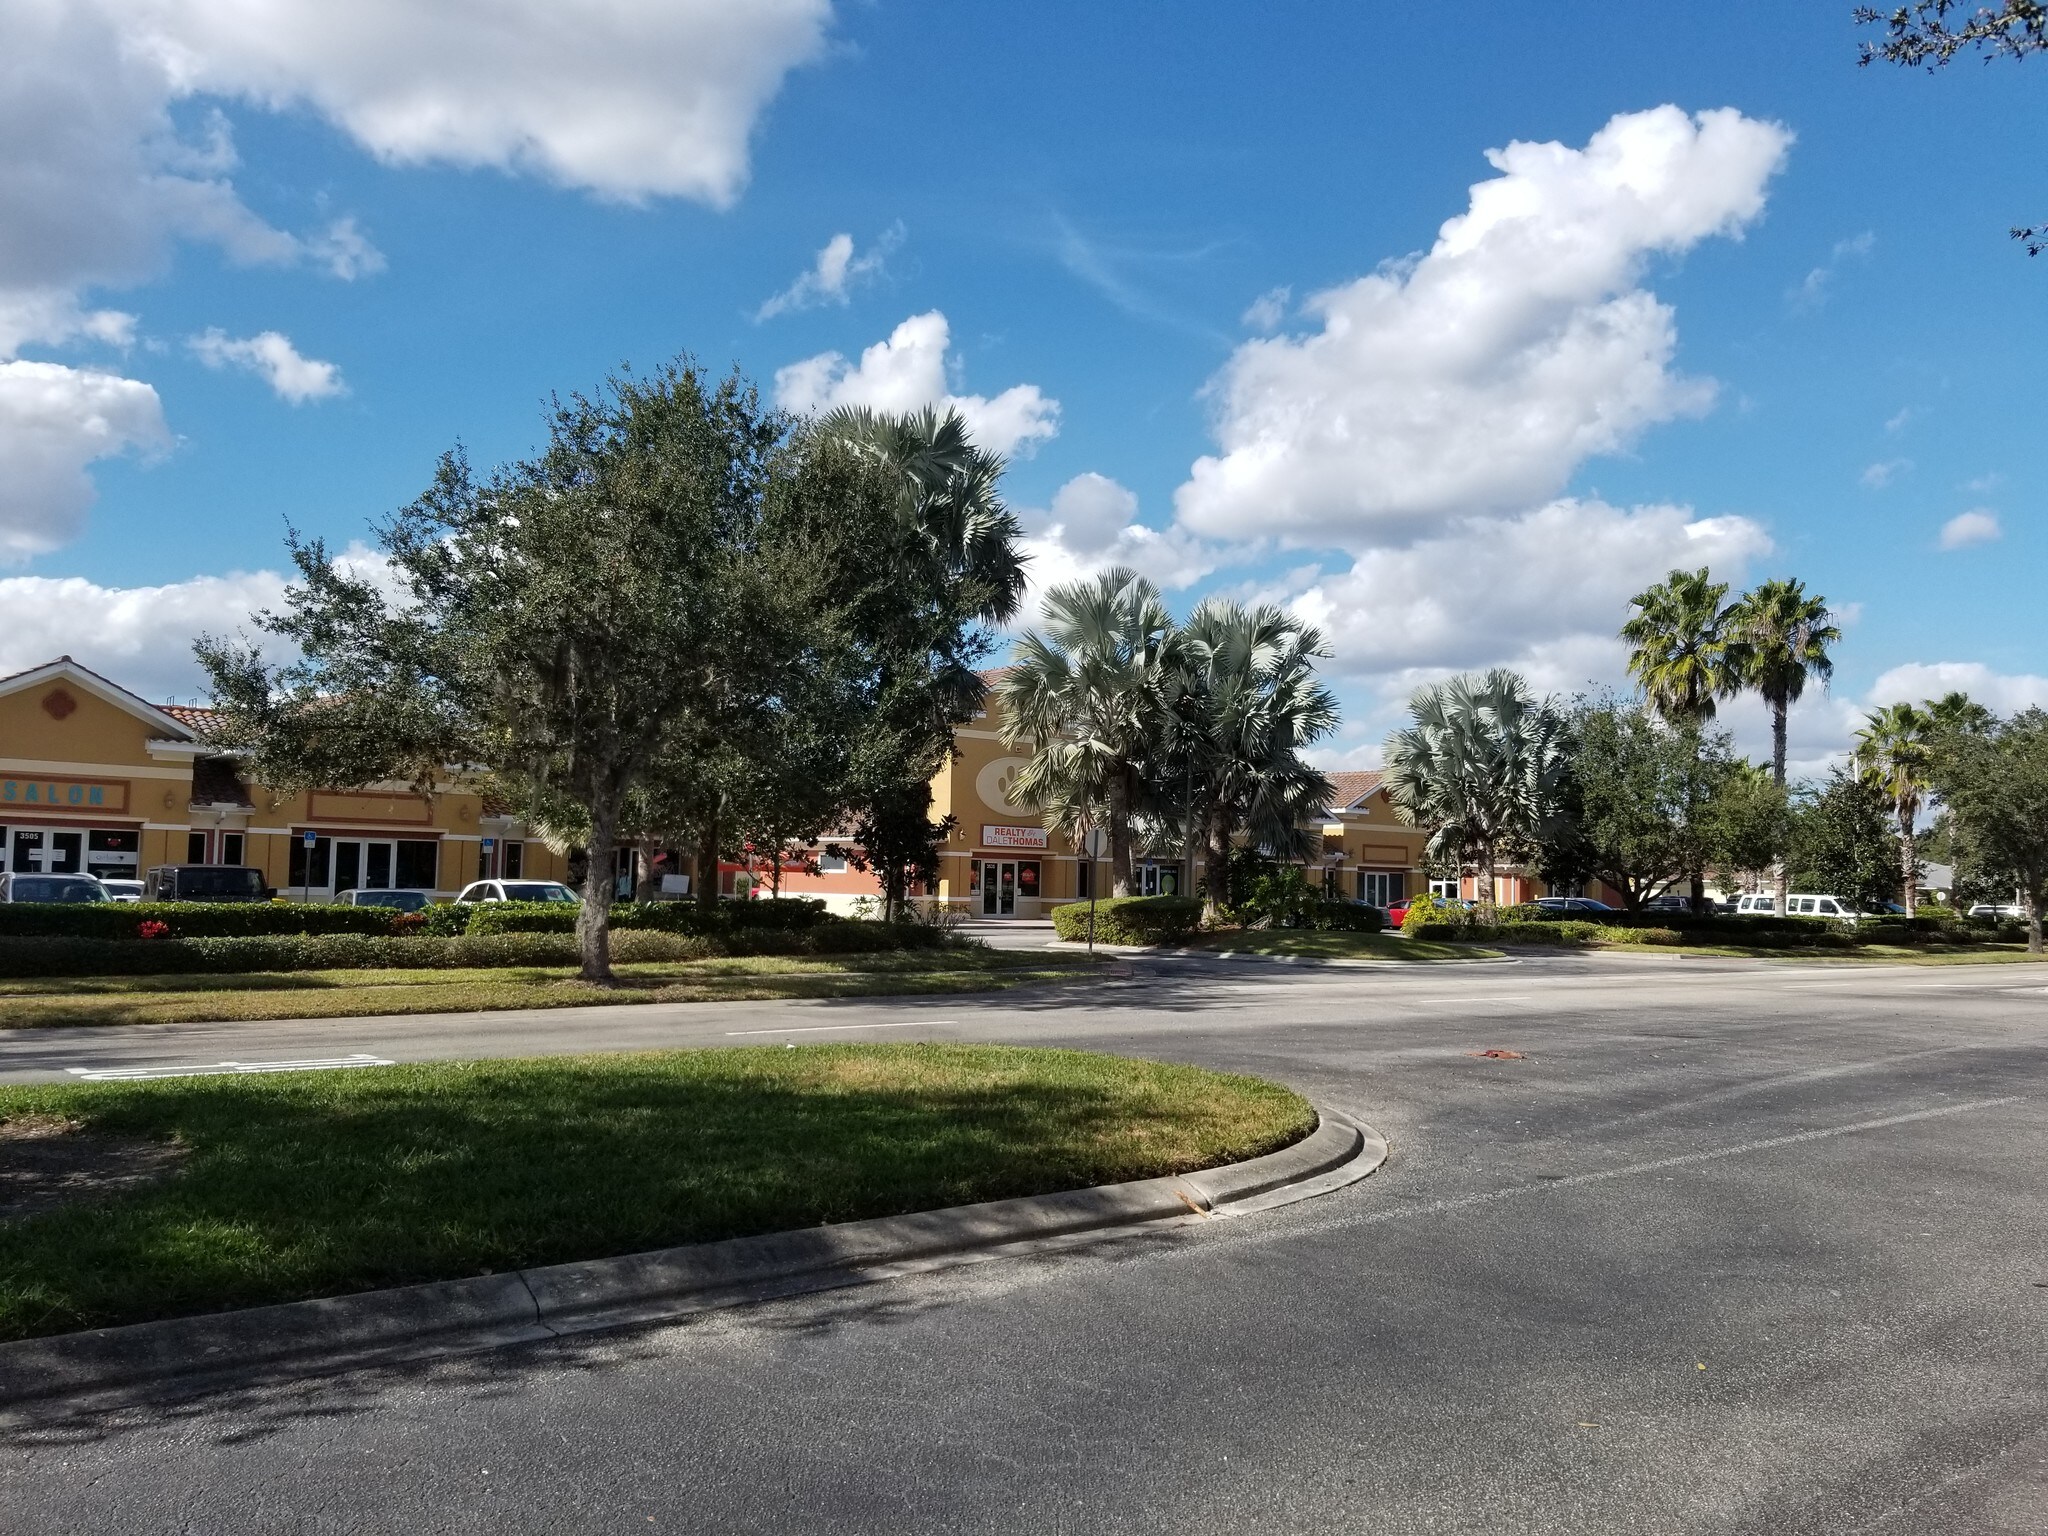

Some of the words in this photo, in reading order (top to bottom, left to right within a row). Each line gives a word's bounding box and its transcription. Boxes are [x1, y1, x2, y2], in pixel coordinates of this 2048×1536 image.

[4, 780, 104, 805] SALON
[20, 832, 39, 840] 3505
[994, 827, 1026, 837] REALTY
